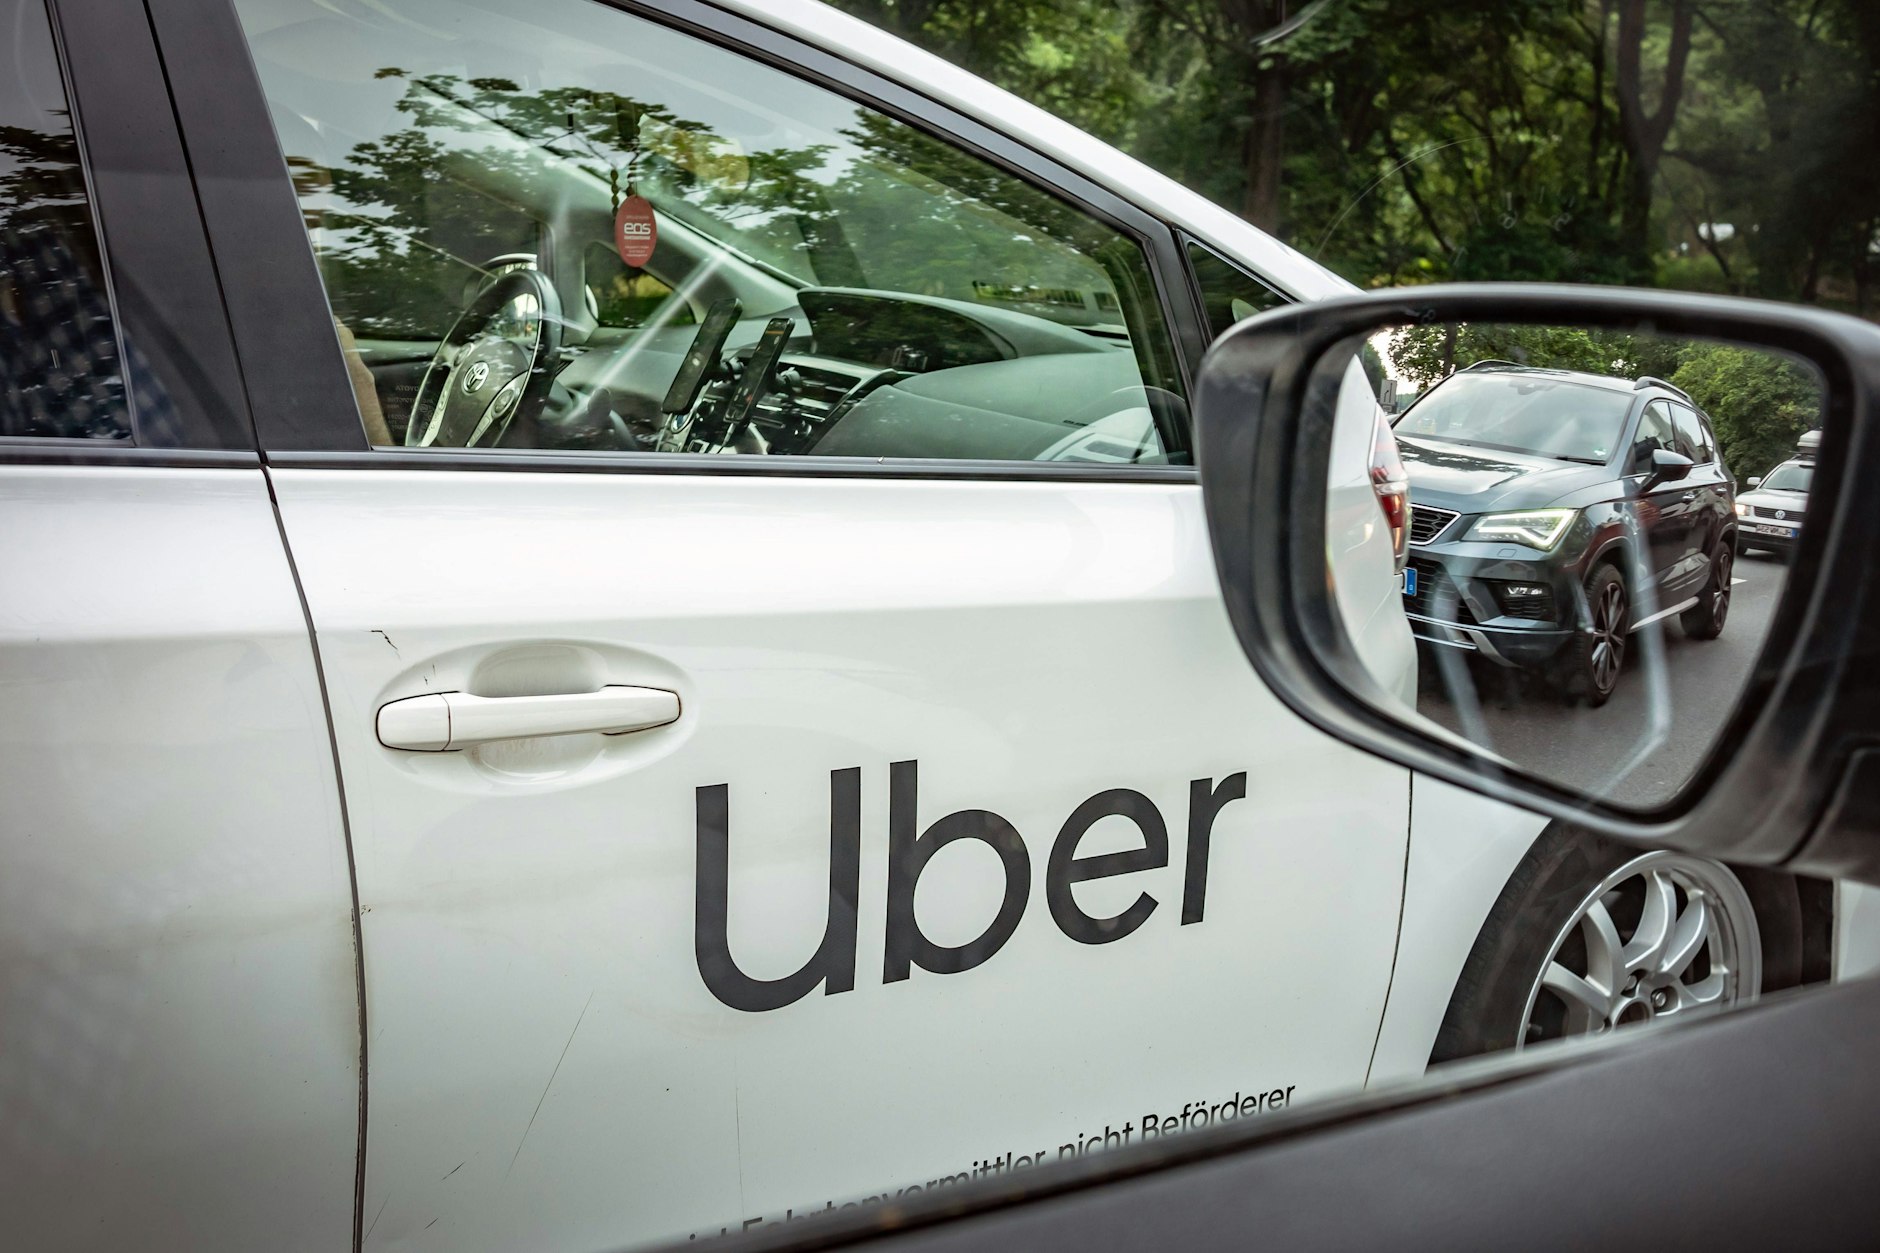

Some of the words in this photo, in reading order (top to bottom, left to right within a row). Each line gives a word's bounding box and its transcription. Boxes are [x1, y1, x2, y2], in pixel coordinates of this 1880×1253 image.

[623, 222, 651, 235] eos
[695, 759, 1247, 1012] Uber
[1058, 1122, 1134, 1160] nicht
[1141, 1084, 1296, 1142] Beförderer
